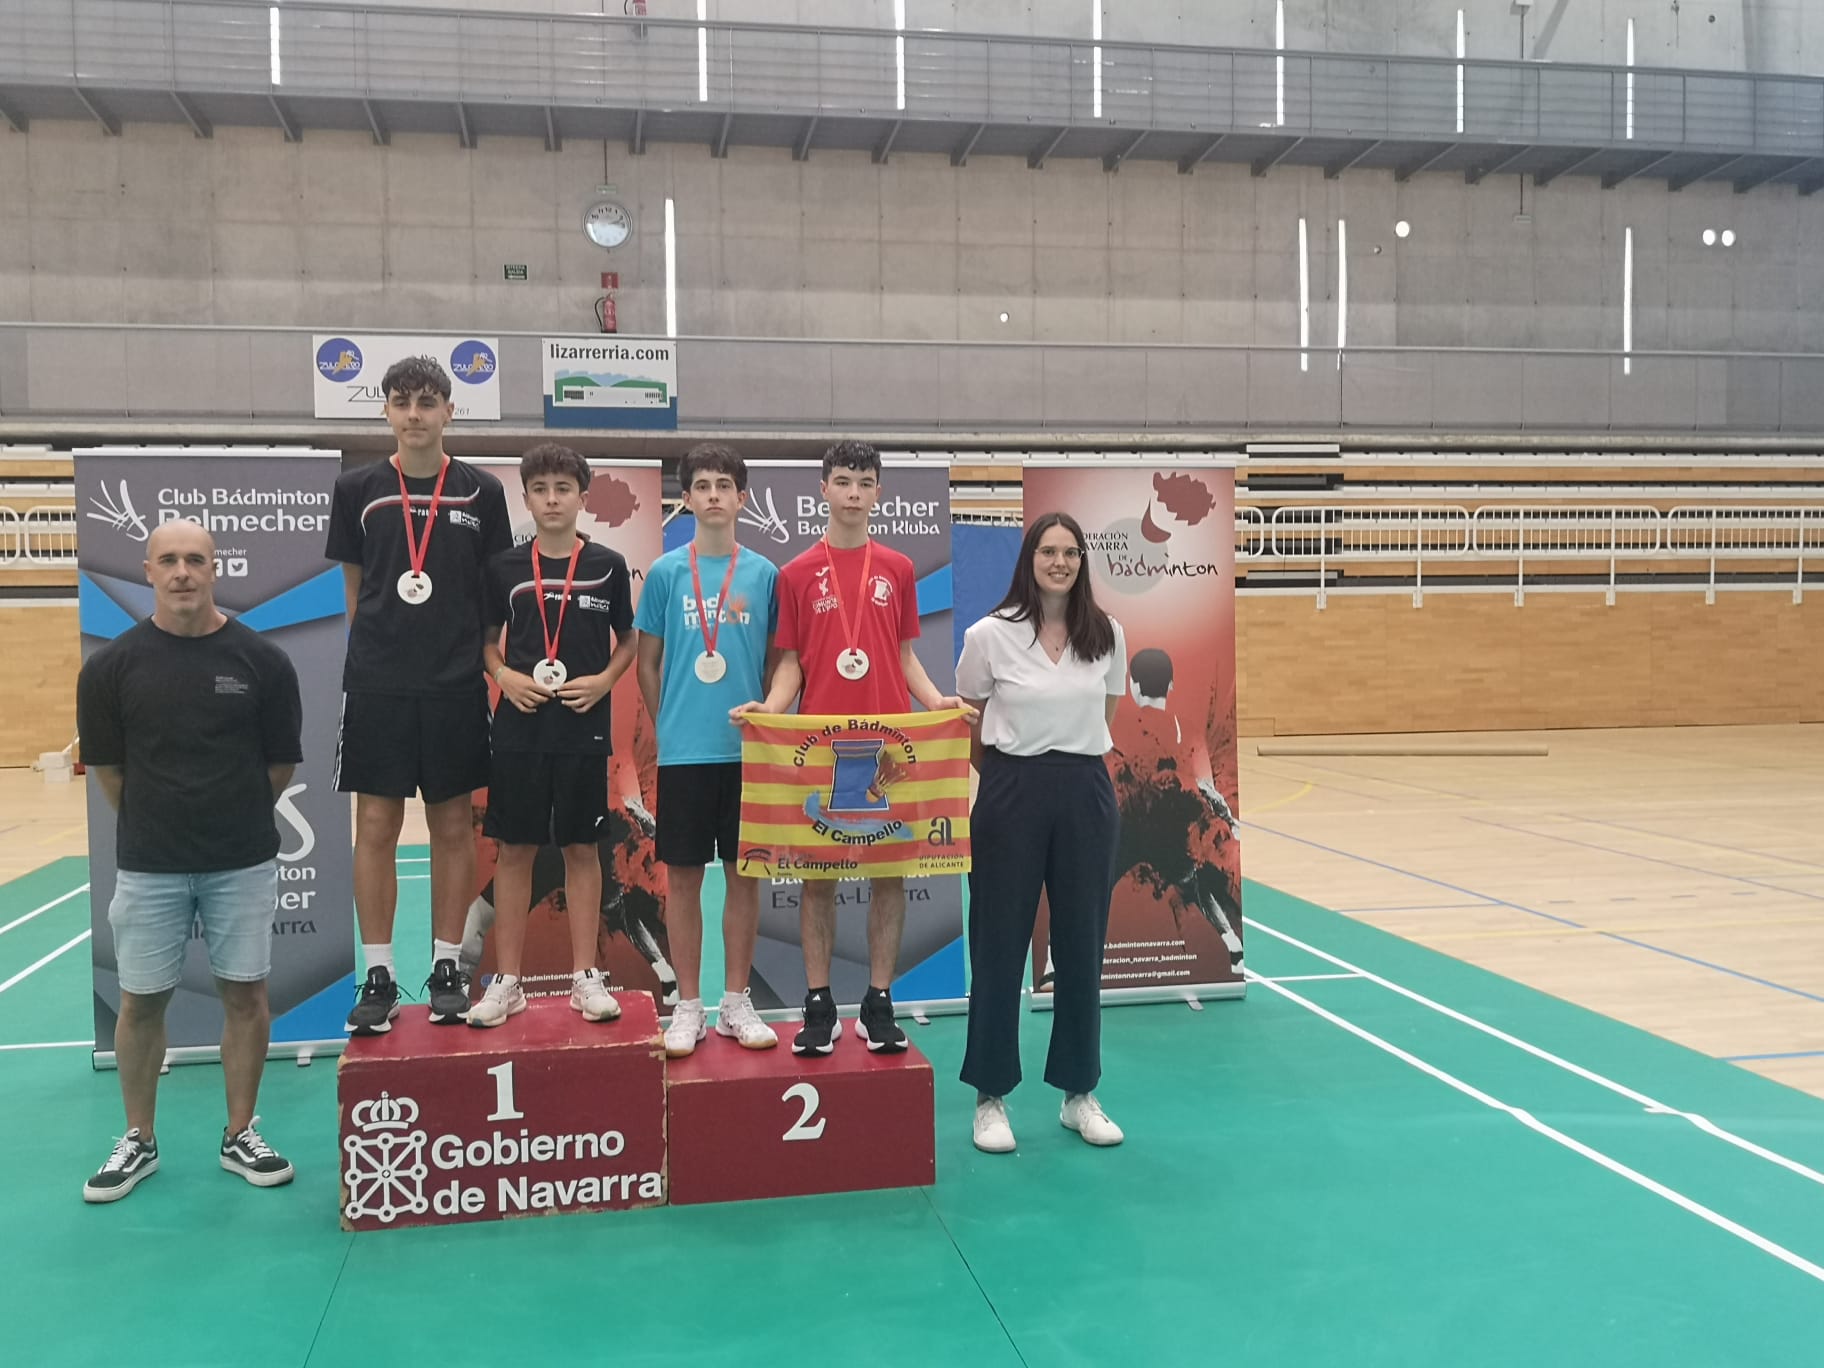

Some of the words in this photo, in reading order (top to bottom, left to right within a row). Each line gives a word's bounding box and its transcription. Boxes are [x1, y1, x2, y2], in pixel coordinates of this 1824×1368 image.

[550, 343, 669, 360] lizarrerria.com
[346, 386, 386, 402] ZUL
[157, 488, 206, 505] Club
[212, 488, 329, 505] Bádminton
[797, 495, 939, 518] Beecher
[893, 519, 940, 535] Kluba
[1086, 542, 1128, 551] AVARRA
[1106, 553, 1218, 577] bádminton
[793, 735, 818, 768] Club
[822, 723, 842, 738] de
[847, 718, 917, 765] Bádminton
[811, 820, 828, 836] El
[831, 819, 903, 846] Campello
[777, 858, 791, 869] El
[794, 857, 858, 872] Campello
[930, 861, 964, 869] ALICANTE
[486, 1061, 524, 1122] 1
[781, 1082, 827, 1141] 2
[431, 1128, 625, 1170] Gobierno
[433, 1178, 485, 1216] de
[498, 1170, 663, 1212] Navarra
